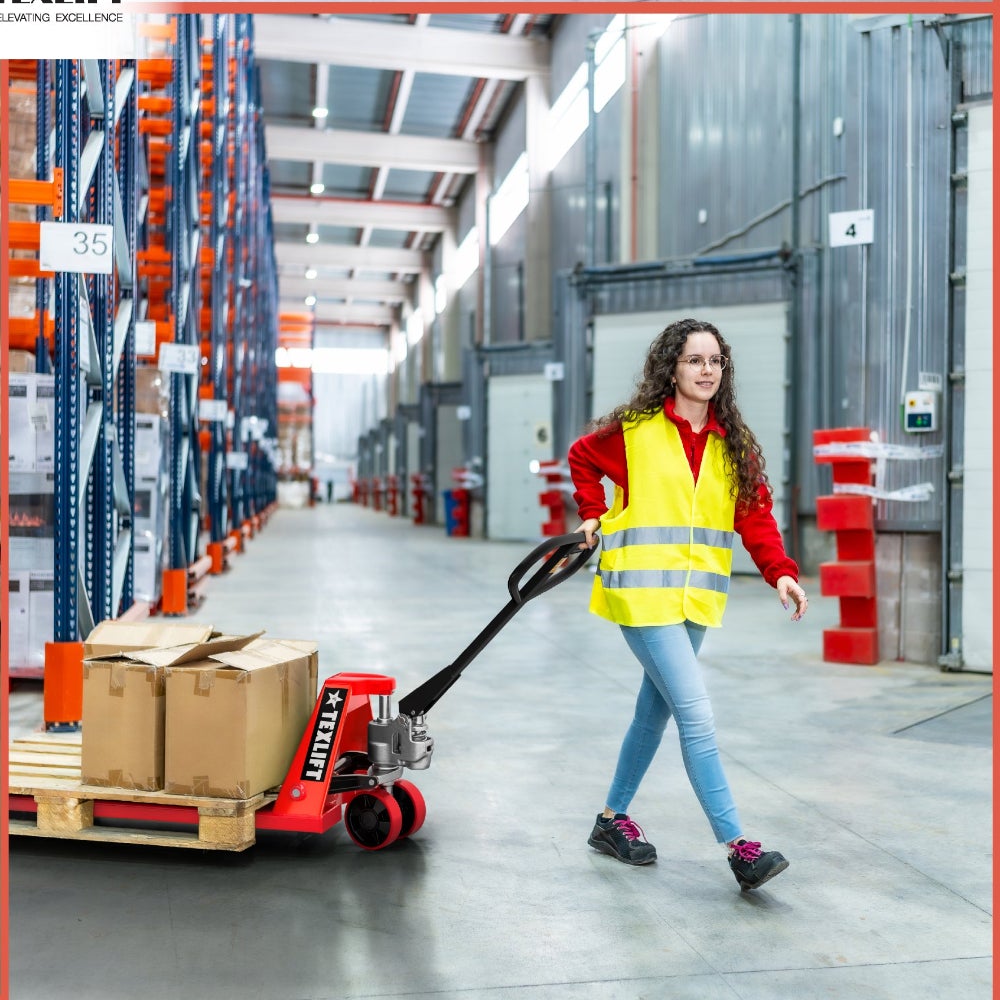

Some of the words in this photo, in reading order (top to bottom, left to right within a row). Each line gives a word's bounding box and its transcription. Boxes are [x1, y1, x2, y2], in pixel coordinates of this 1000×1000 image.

[845, 223, 857, 237] 4
[73, 231, 108, 256] 35
[305, 710, 339, 781] TEXLIFT
